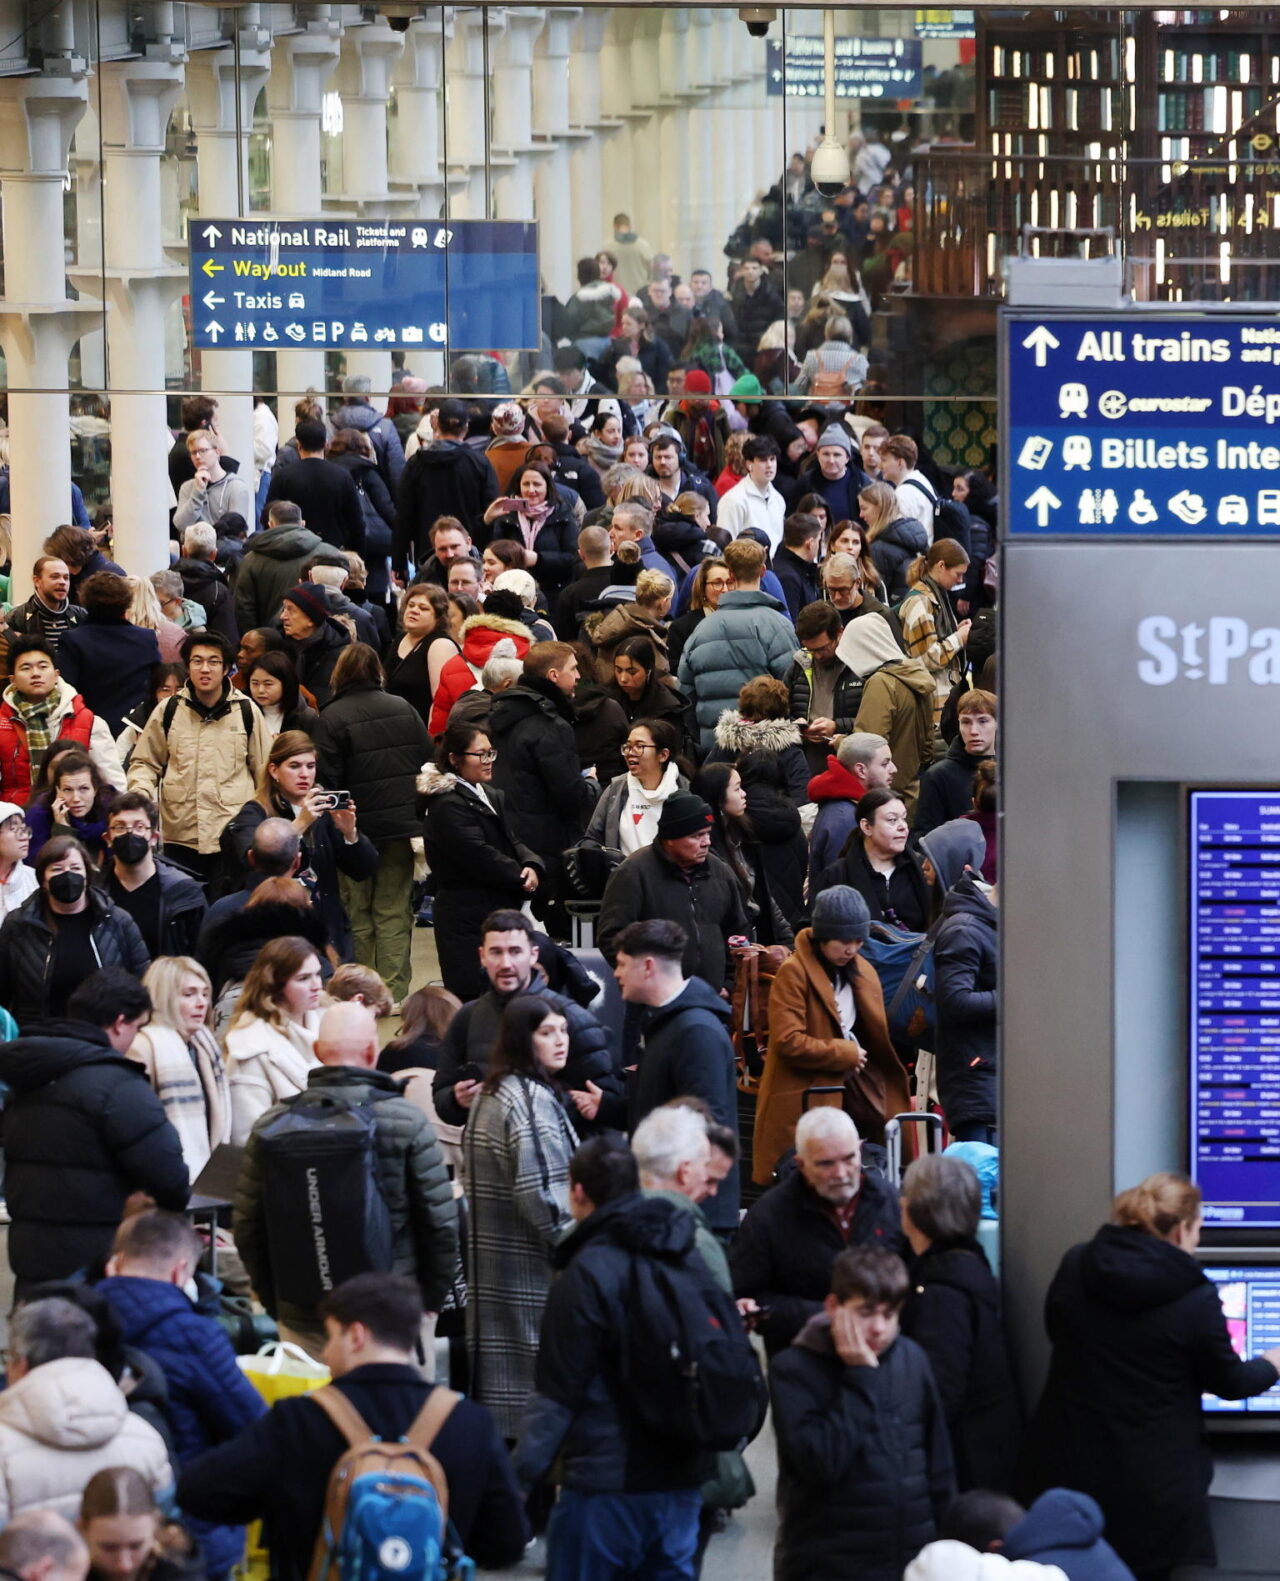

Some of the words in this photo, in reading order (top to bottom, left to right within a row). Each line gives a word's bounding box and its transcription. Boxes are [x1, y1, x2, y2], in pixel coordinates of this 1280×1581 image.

[232, 228, 310, 247] National
[314, 228, 351, 247] Rail
[356, 226, 388, 237] Tickets
[389, 227, 406, 237] and
[356, 237, 400, 248] platforms
[233, 260, 273, 280] Way
[276, 262, 307, 277] out
[312, 268, 348, 277] Midland
[348, 268, 372, 277] Road
[233, 291, 283, 309] Taxis
[1076, 331, 1126, 362] All
[1131, 331, 1231, 362] trains
[1240, 347, 1272, 362] and
[1128, 396, 1213, 412] eurostar
[1101, 438, 1209, 470] Billets
[306, 1167, 323, 1223] UNDER
[312, 1224, 333, 1291] ARMOUR
